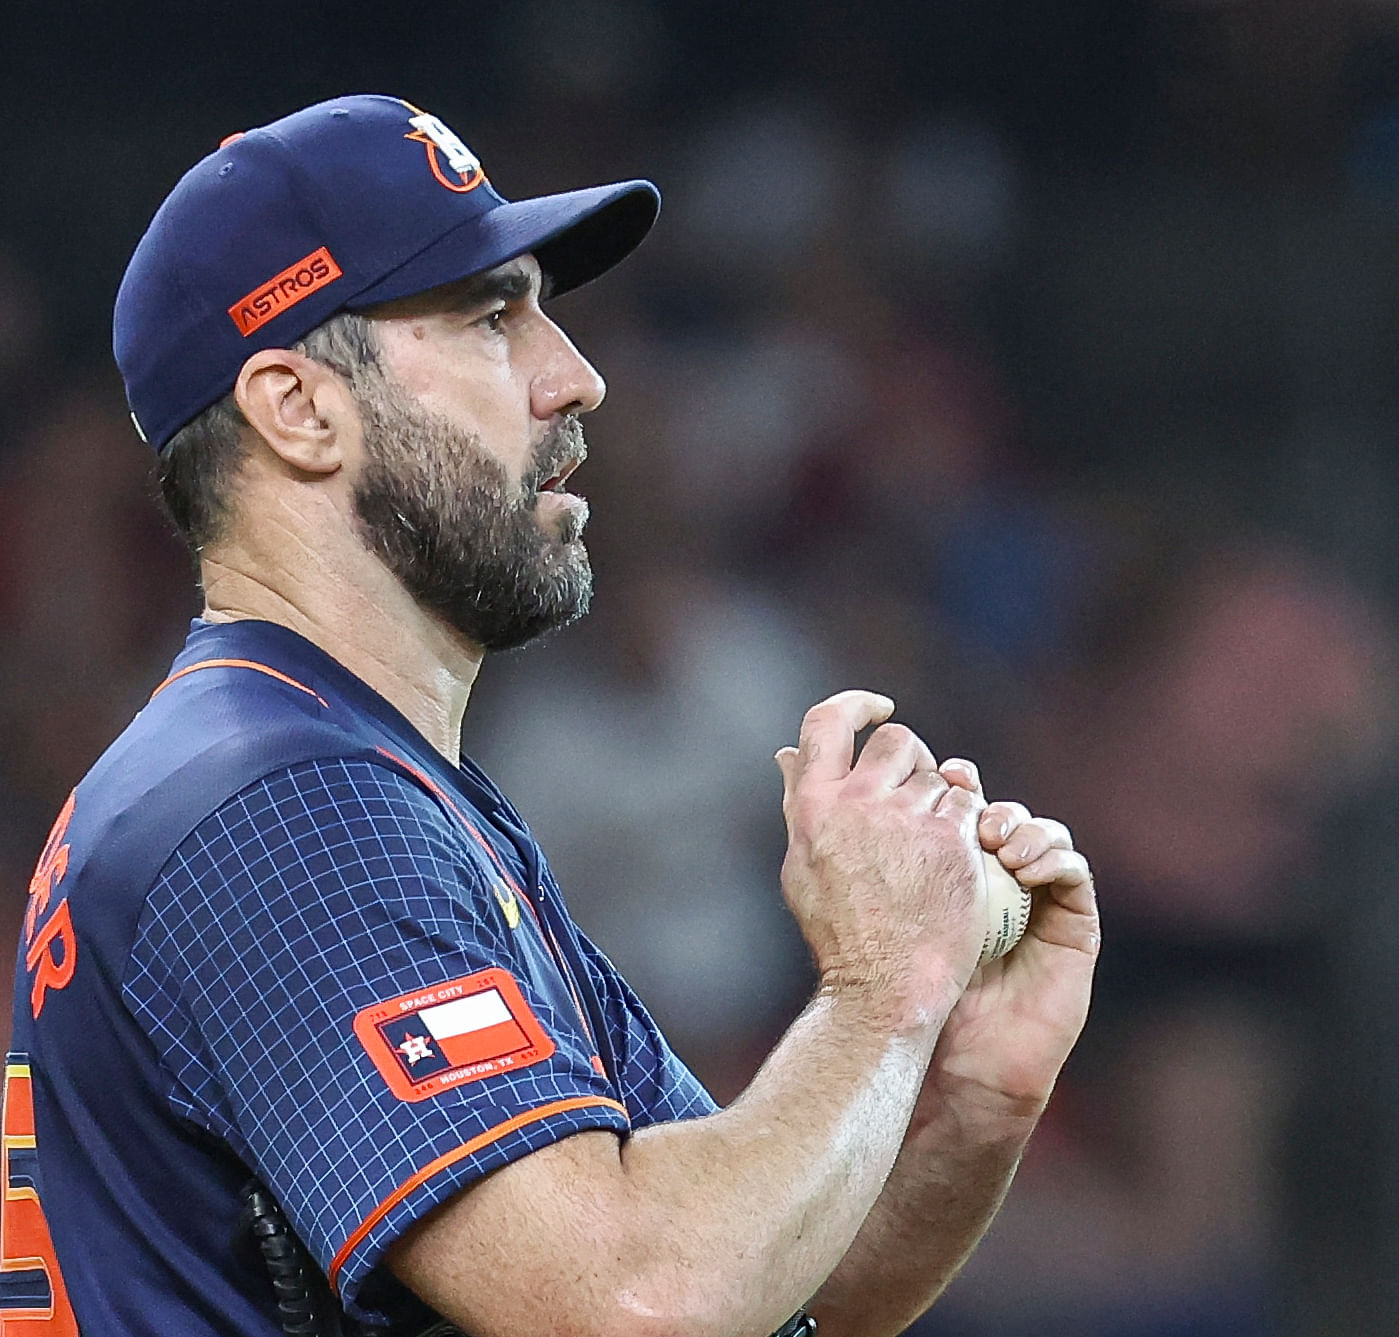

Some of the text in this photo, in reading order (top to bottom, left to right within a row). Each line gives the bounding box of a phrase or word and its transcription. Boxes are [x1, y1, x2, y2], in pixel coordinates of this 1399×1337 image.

[241, 257, 330, 327] ASTROS
[399, 985, 463, 1011] SPACE CITY
[399, 1036, 433, 1063] H
[439, 1056, 514, 1085] HOUSTON, TX
